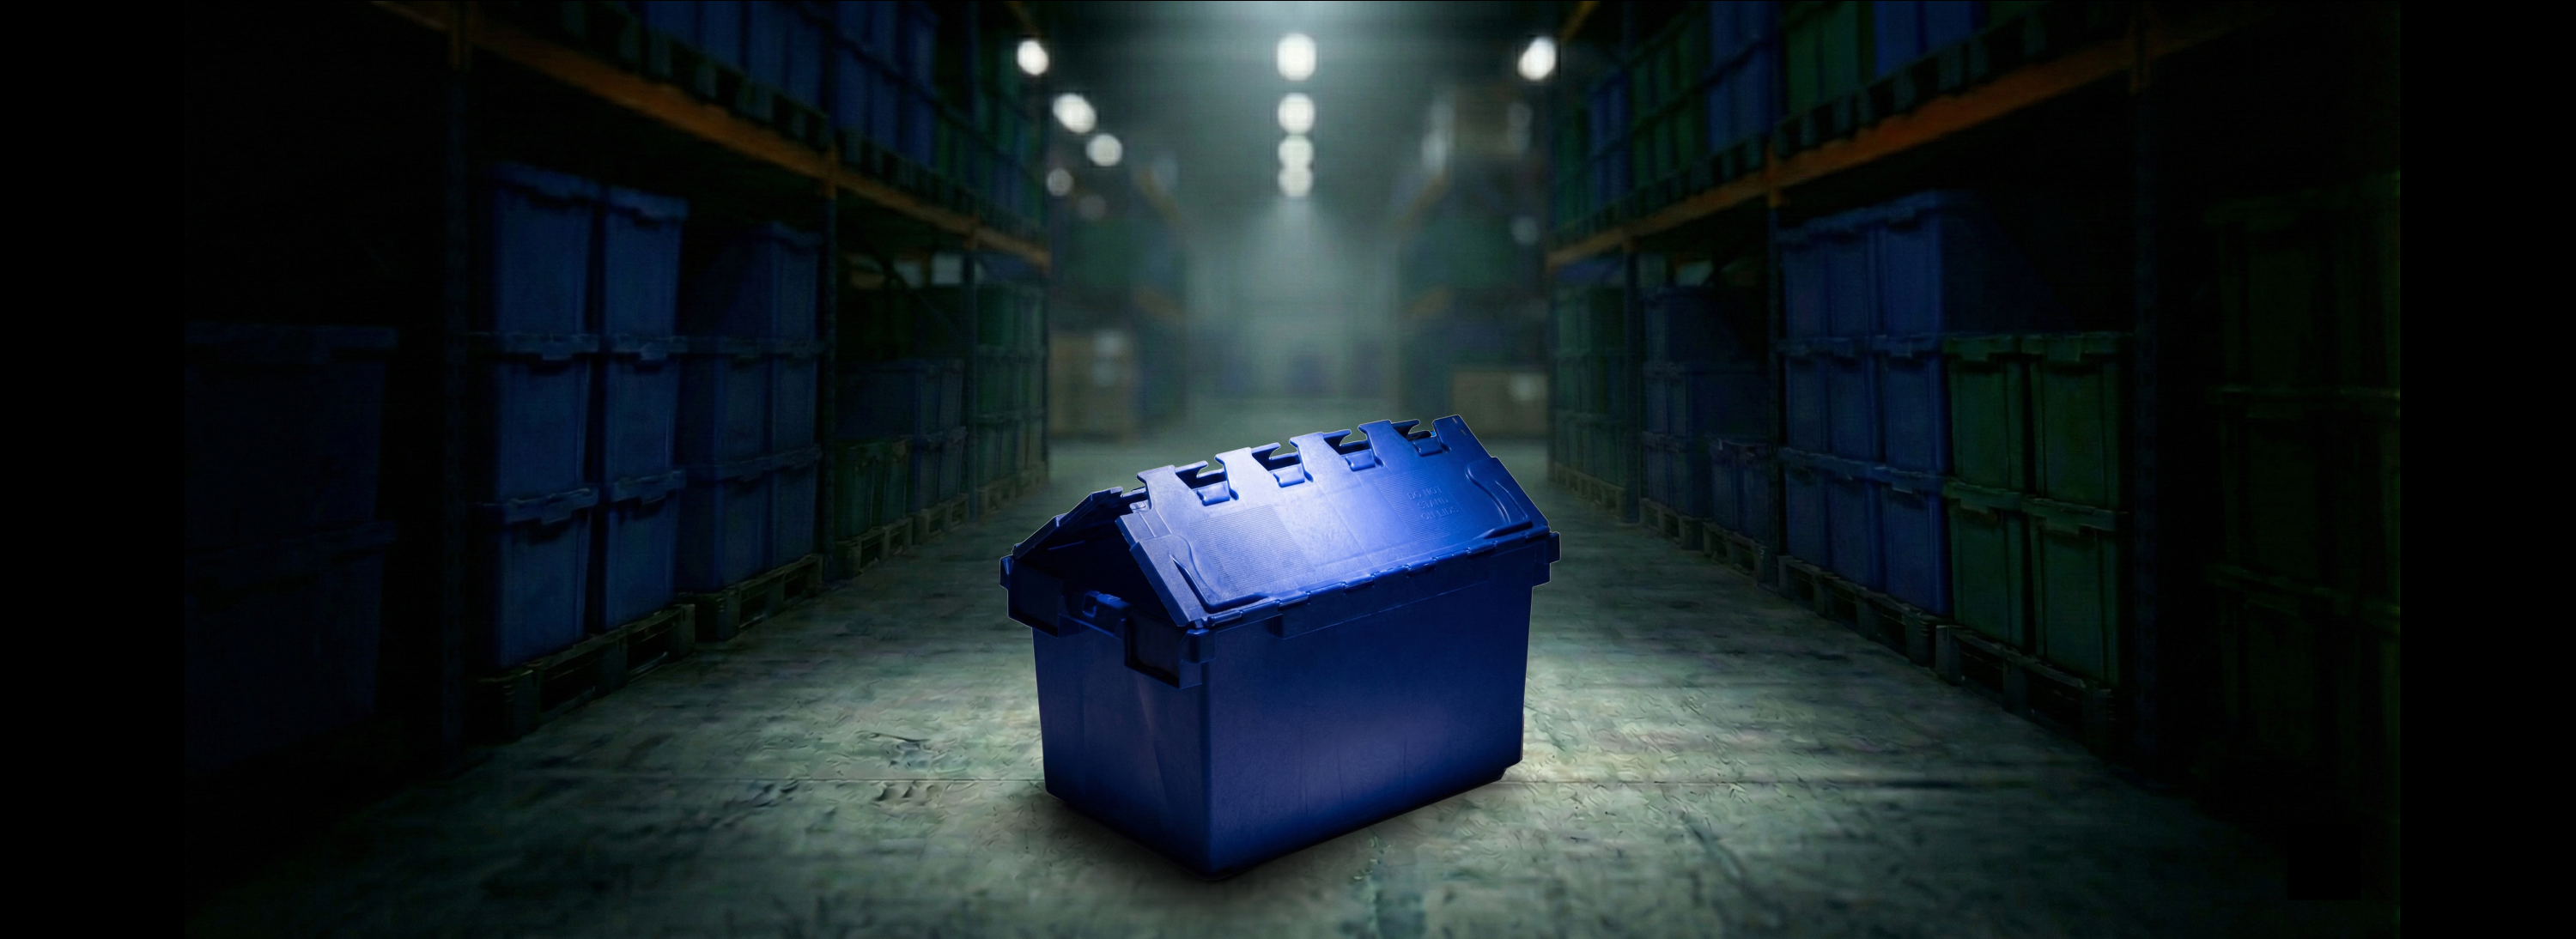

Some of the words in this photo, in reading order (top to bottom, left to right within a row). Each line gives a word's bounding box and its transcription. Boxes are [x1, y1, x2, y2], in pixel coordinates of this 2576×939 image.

[1406, 490, 1422, 500] DO
[1422, 485, 1443, 497] NOT
[1417, 497, 1449, 510] STAND
[1420, 511, 1437, 521] ON
[1436, 506, 1459, 518] LIDS
